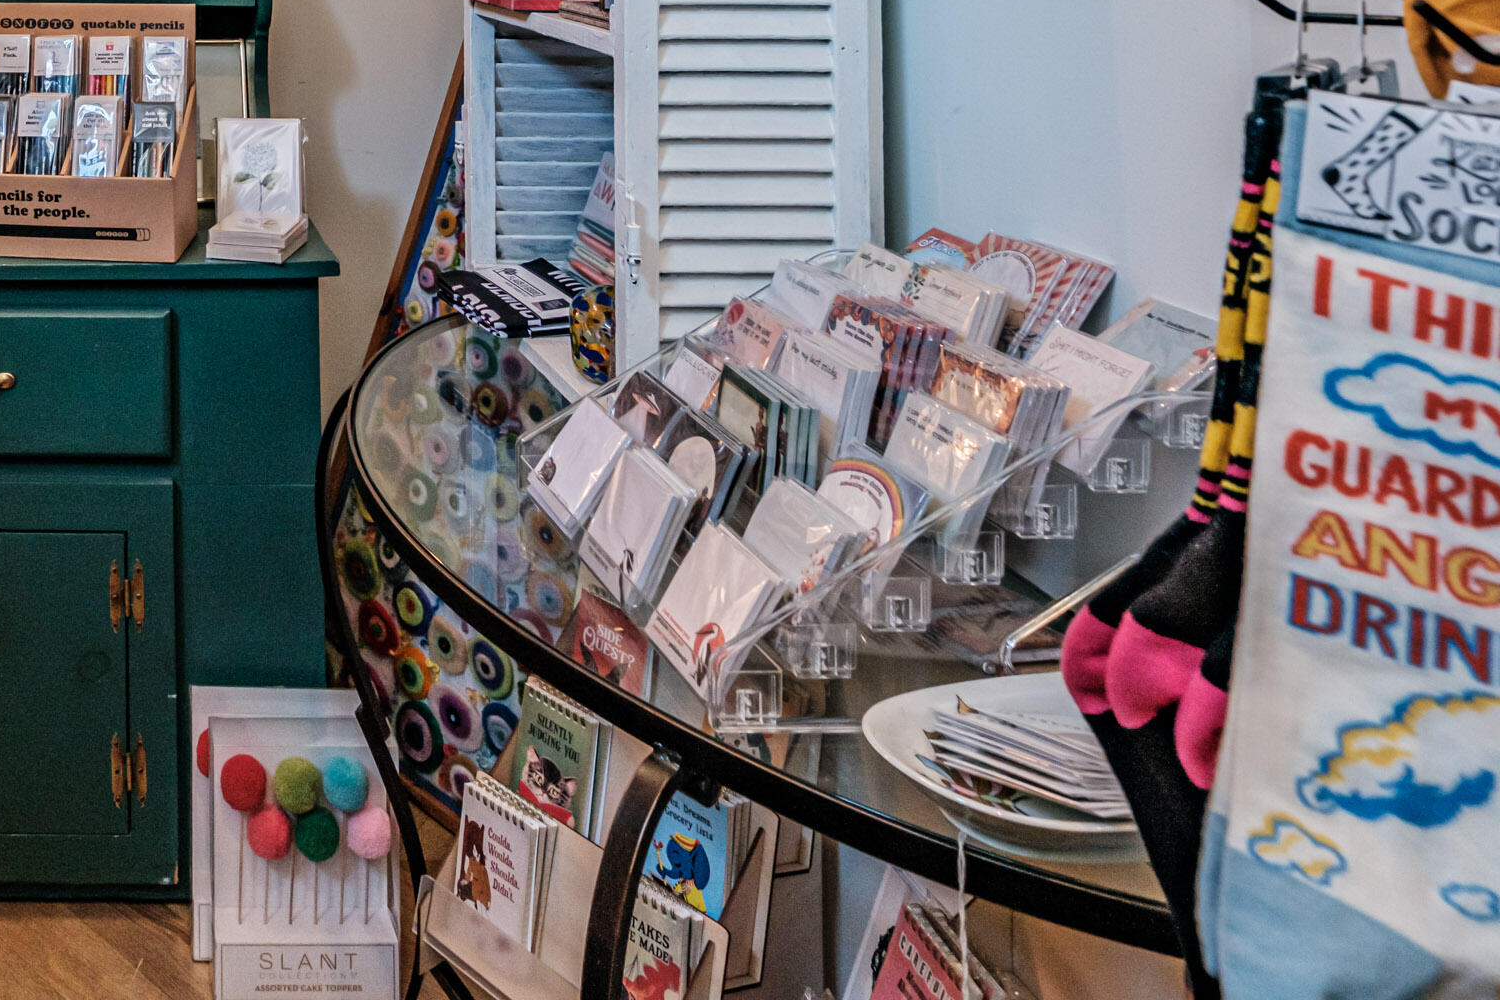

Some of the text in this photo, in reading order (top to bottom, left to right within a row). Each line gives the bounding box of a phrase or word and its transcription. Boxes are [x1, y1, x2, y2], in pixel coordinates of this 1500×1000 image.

[0, 18, 185, 32] SNIFTY quotable pencils
[38, 190, 62, 203] for
[3, 204, 29, 216] the
[33, 206, 91, 220] people.
[1392, 191, 1500, 254] SOC
[1313, 255, 1500, 361] I THI
[1284, 427, 1500, 530] GUARD
[1290, 508, 1500, 609] ANG
[597, 623, 622, 648] SIDE
[1287, 570, 1491, 685] DRIN
[582, 626, 636, 669] QUEST?
[536, 712, 574, 745] SILENTLY
[527, 722, 580, 765] JUDGING YOU
[487, 826, 513, 852] Coulda.
[695, 826, 714, 842] Lists
[488, 842, 515, 871] Woulda.
[490, 860, 520, 891] Shoulda.
[492, 878, 515, 904] Didn't.
[259, 952, 358, 970] SLANT
[639, 939, 670, 964] MADE
[255, 984, 363, 992] ASSORTED CAKE TOPPERS
